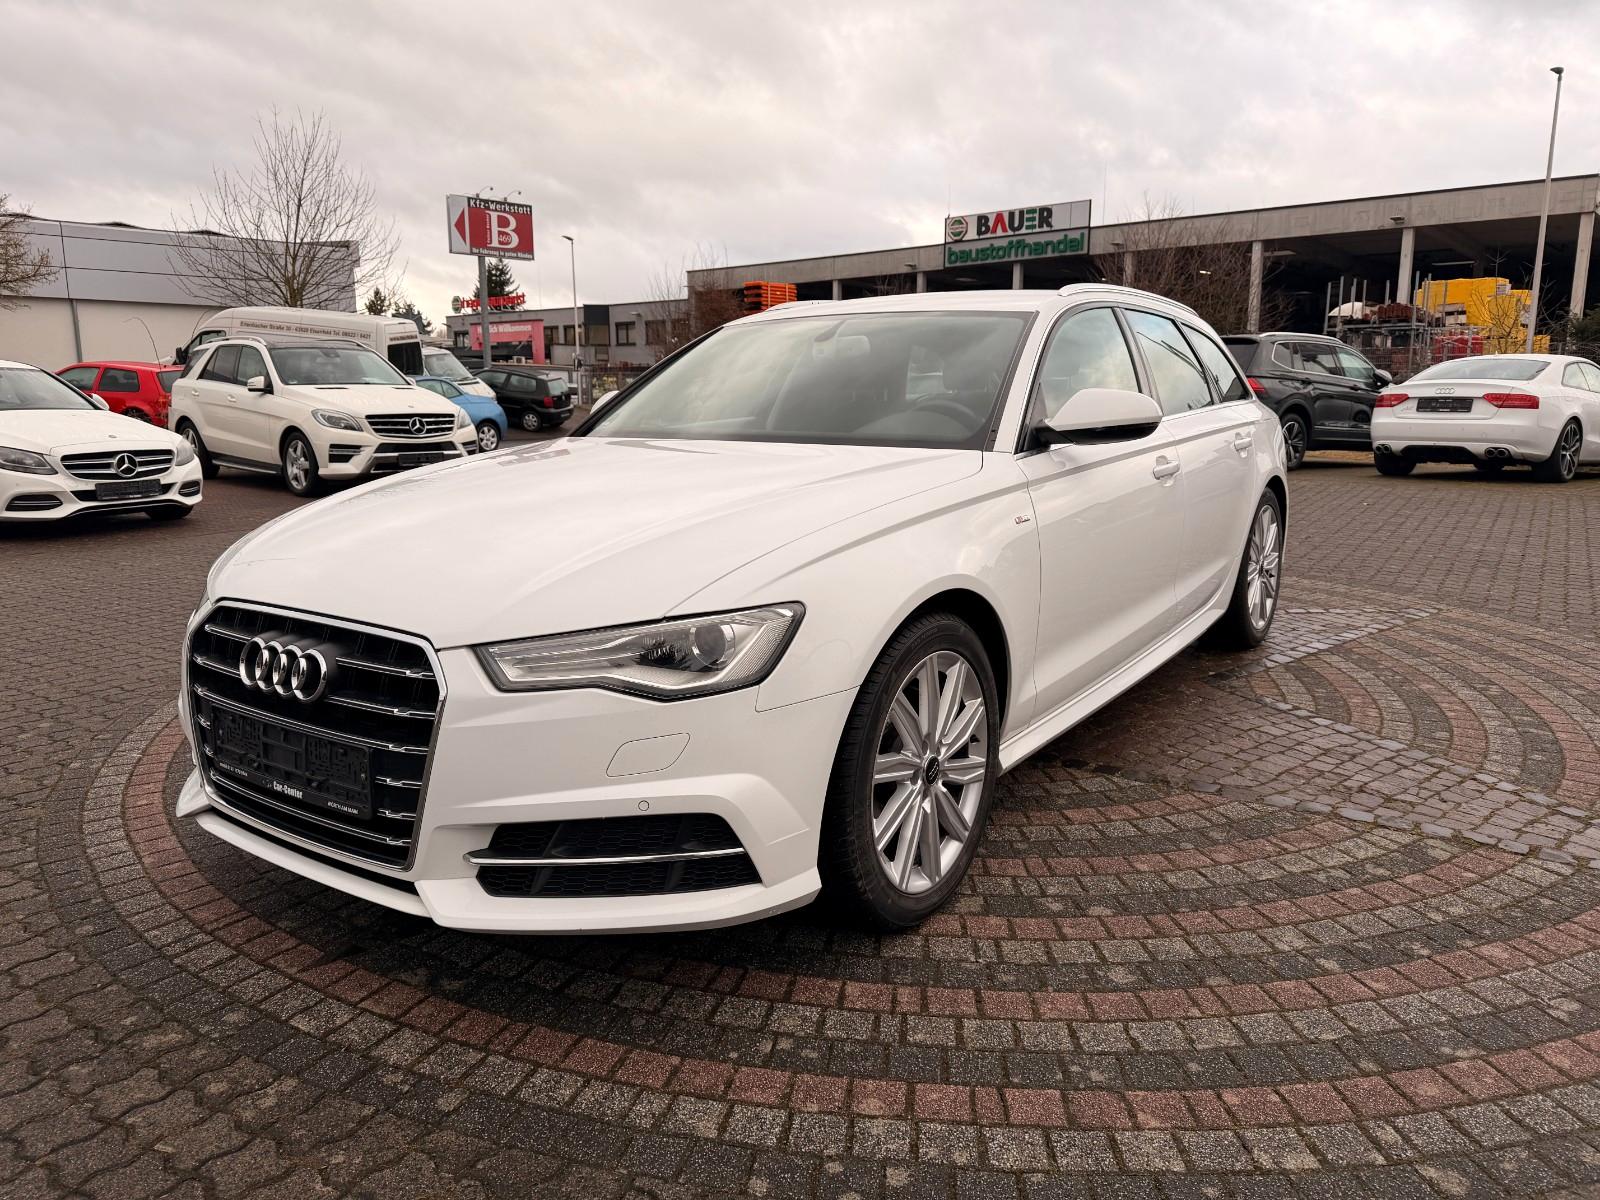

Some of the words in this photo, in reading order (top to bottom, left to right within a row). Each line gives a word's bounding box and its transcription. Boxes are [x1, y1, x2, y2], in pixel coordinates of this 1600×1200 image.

[470, 199, 531, 215] Kfz-Werkstatt
[485, 211, 519, 249] B
[977, 207, 1053, 236] BAUER
[499, 234, 512, 243] 469
[947, 232, 1085, 265] baustoffhandel
[499, 323, 532, 333] Willkommen
[273, 780, 303, 799] Car-Center
